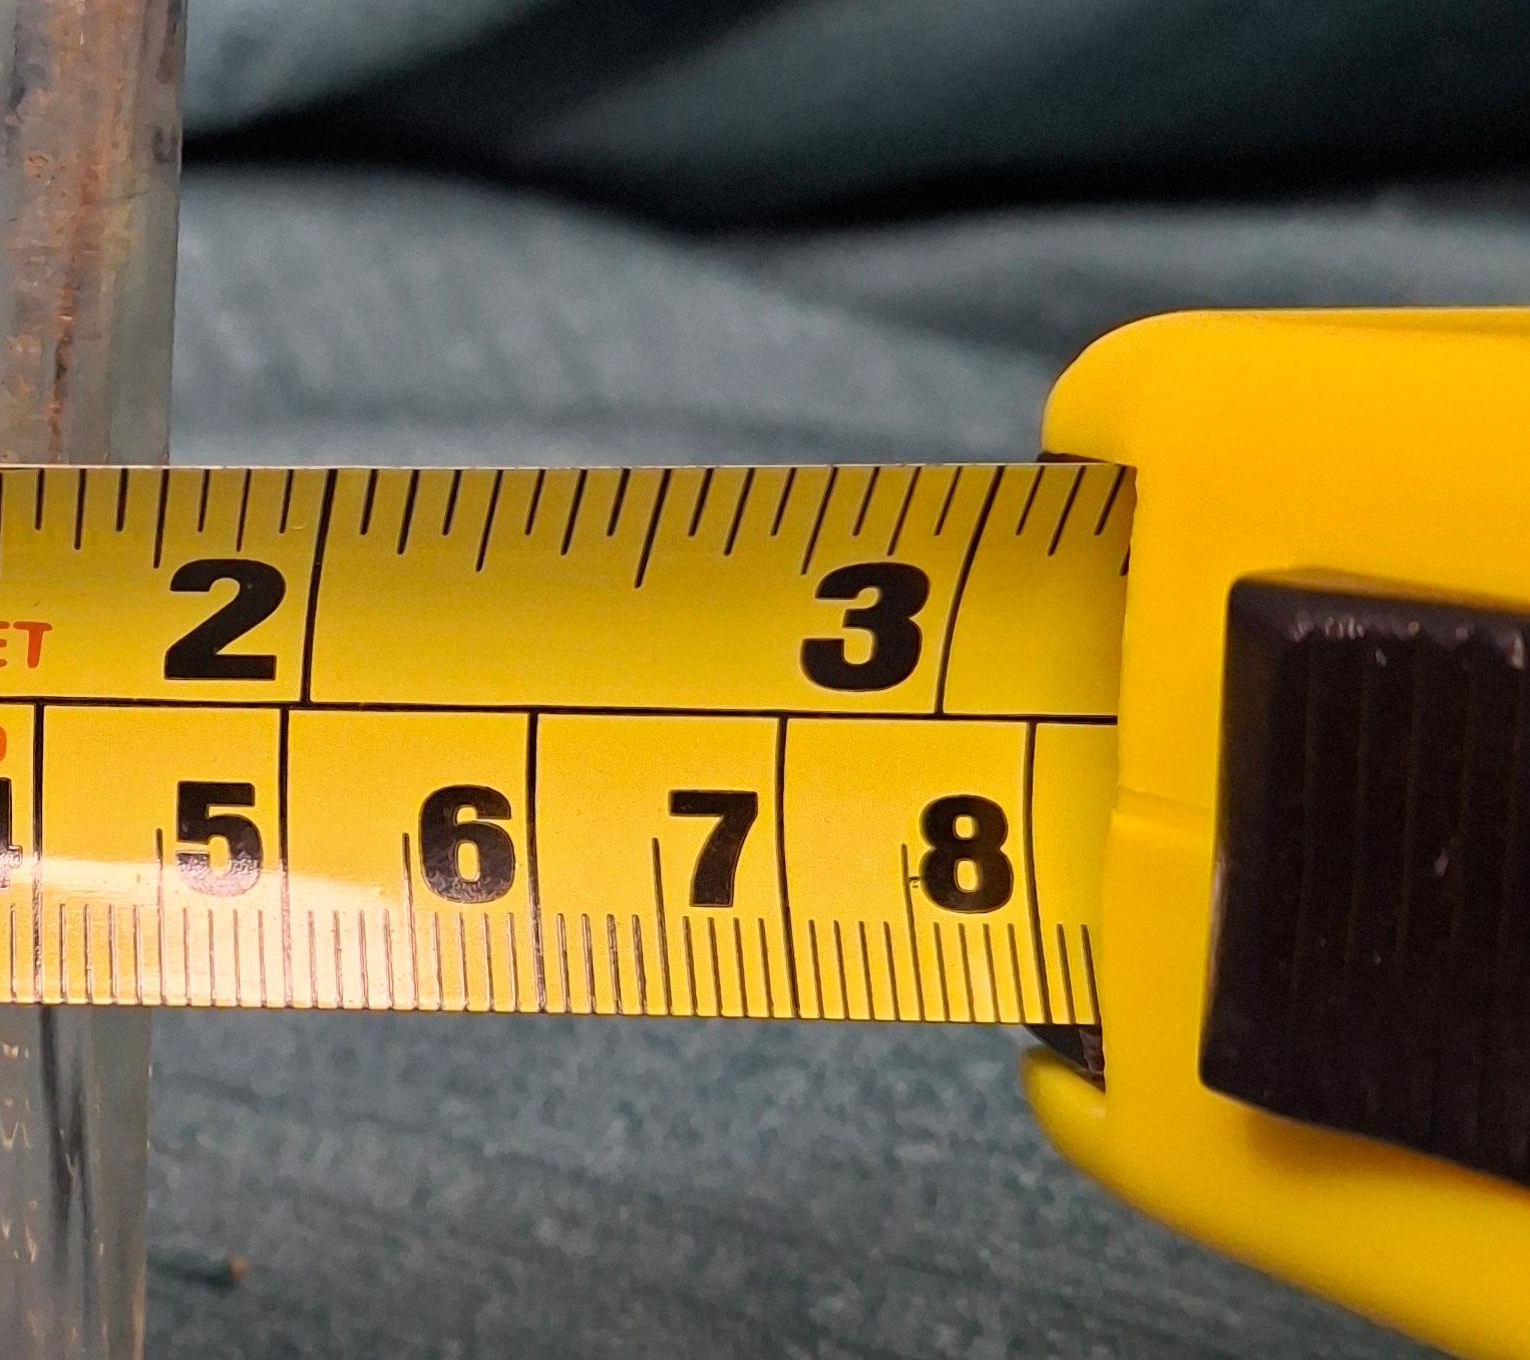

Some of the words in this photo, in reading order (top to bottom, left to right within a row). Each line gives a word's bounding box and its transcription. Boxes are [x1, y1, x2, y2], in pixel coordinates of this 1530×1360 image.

[164, 558, 287, 681] 2
[800, 562, 929, 692] 3
[175, 781, 263, 897] 5
[418, 784, 516, 904] 6
[669, 790, 759, 908] 7
[919, 794, 1014, 914] 8
